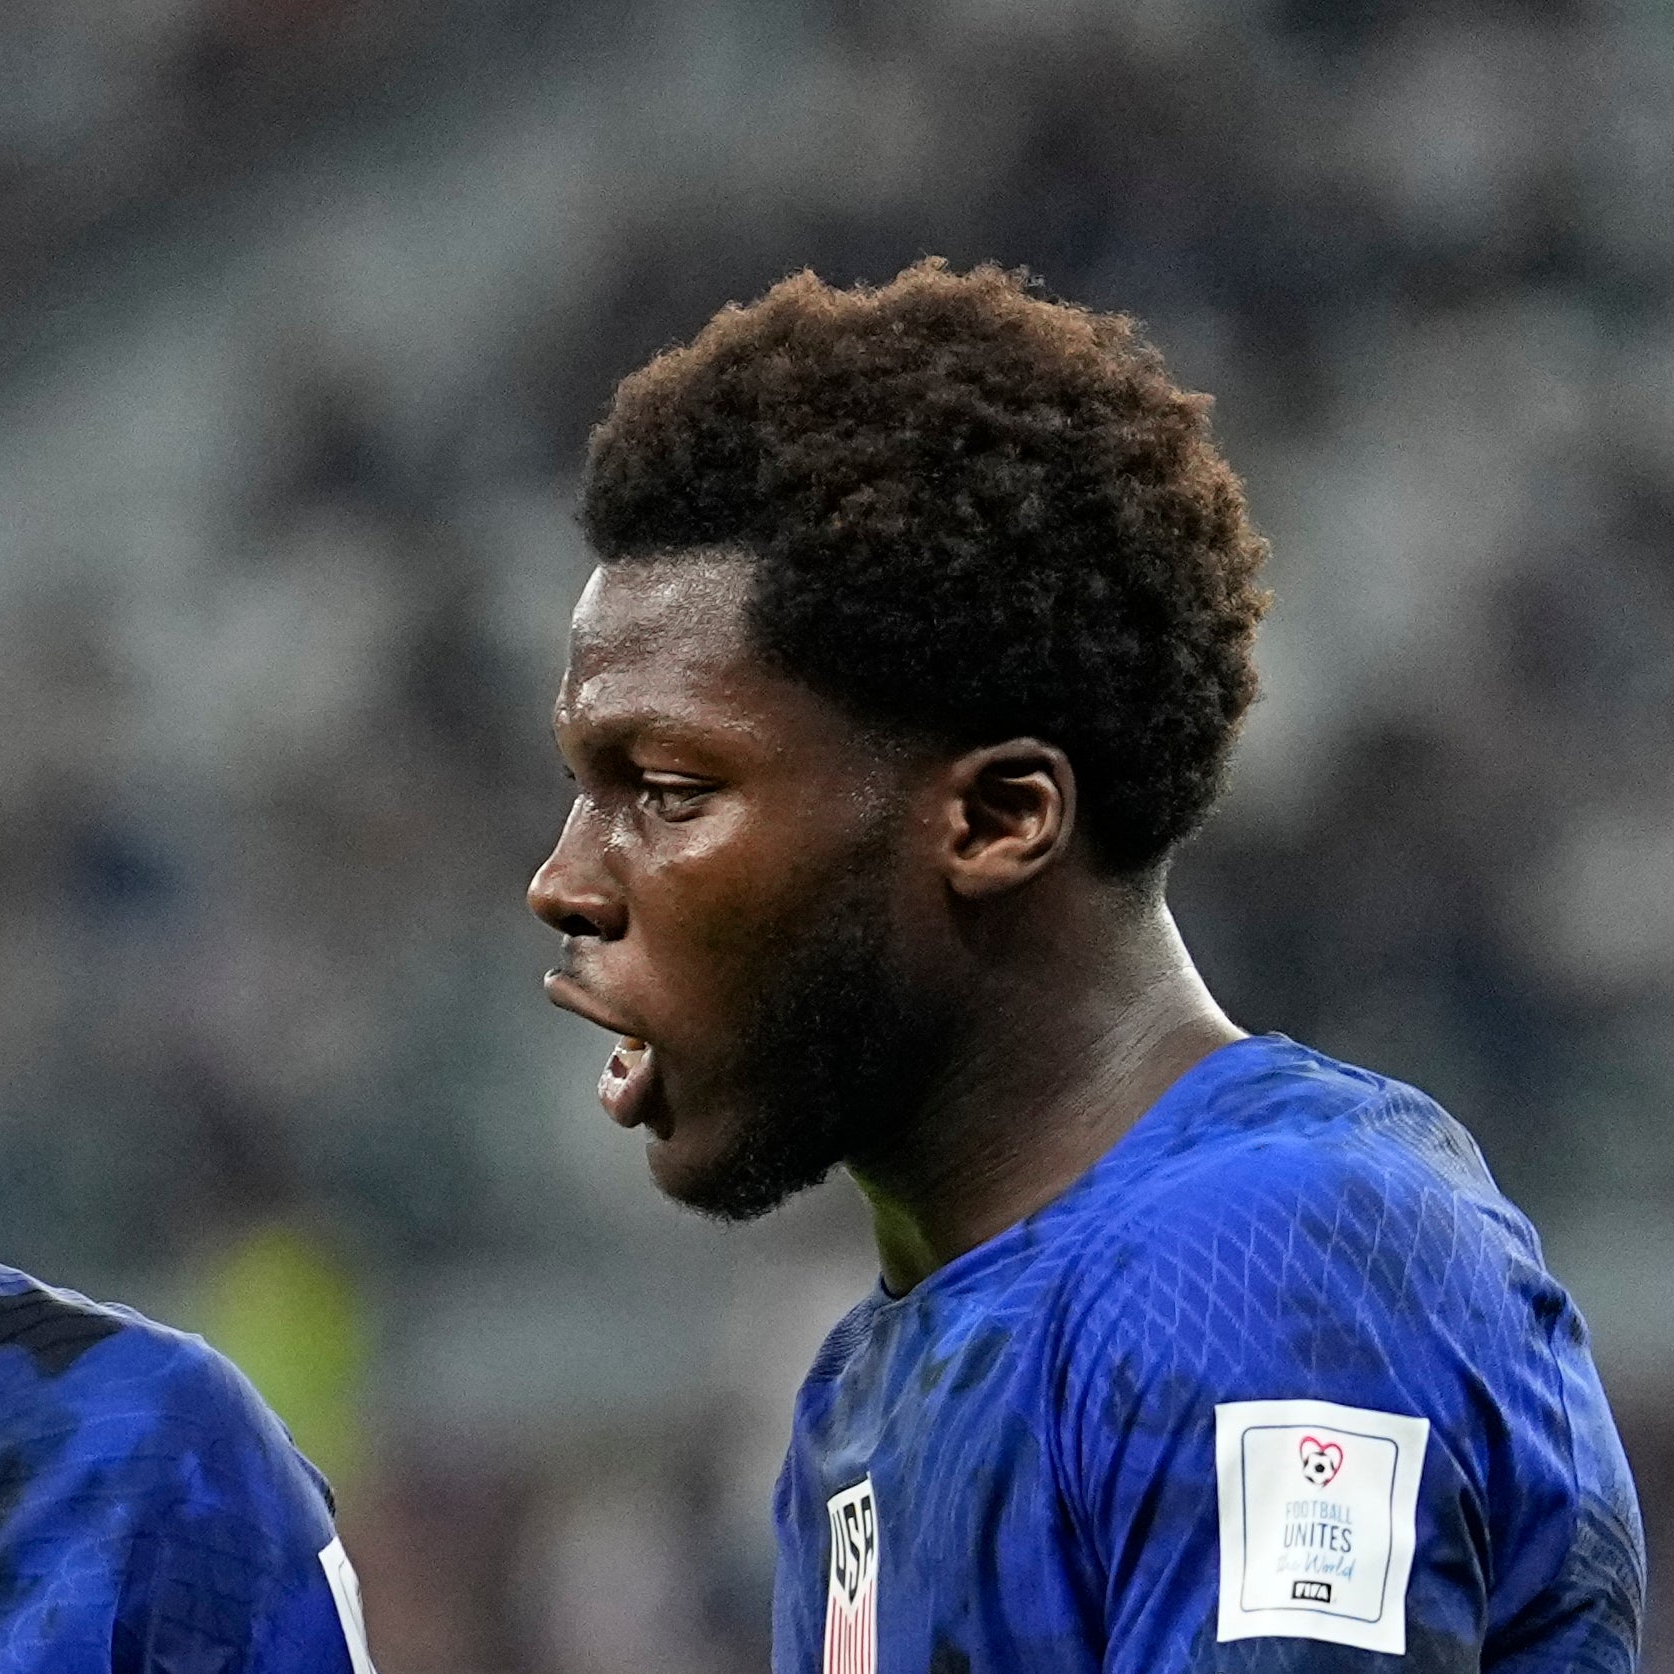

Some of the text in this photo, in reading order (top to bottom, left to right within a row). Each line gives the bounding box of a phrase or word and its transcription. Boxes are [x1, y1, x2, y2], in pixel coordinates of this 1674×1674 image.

[1285, 1499, 1351, 1524] FOOTBALL
[831, 1495, 874, 1605] USA
[1283, 1522, 1352, 1553] UNITES
[1304, 1552, 1357, 1582] World
[1293, 1581, 1331, 1602] FIFA
